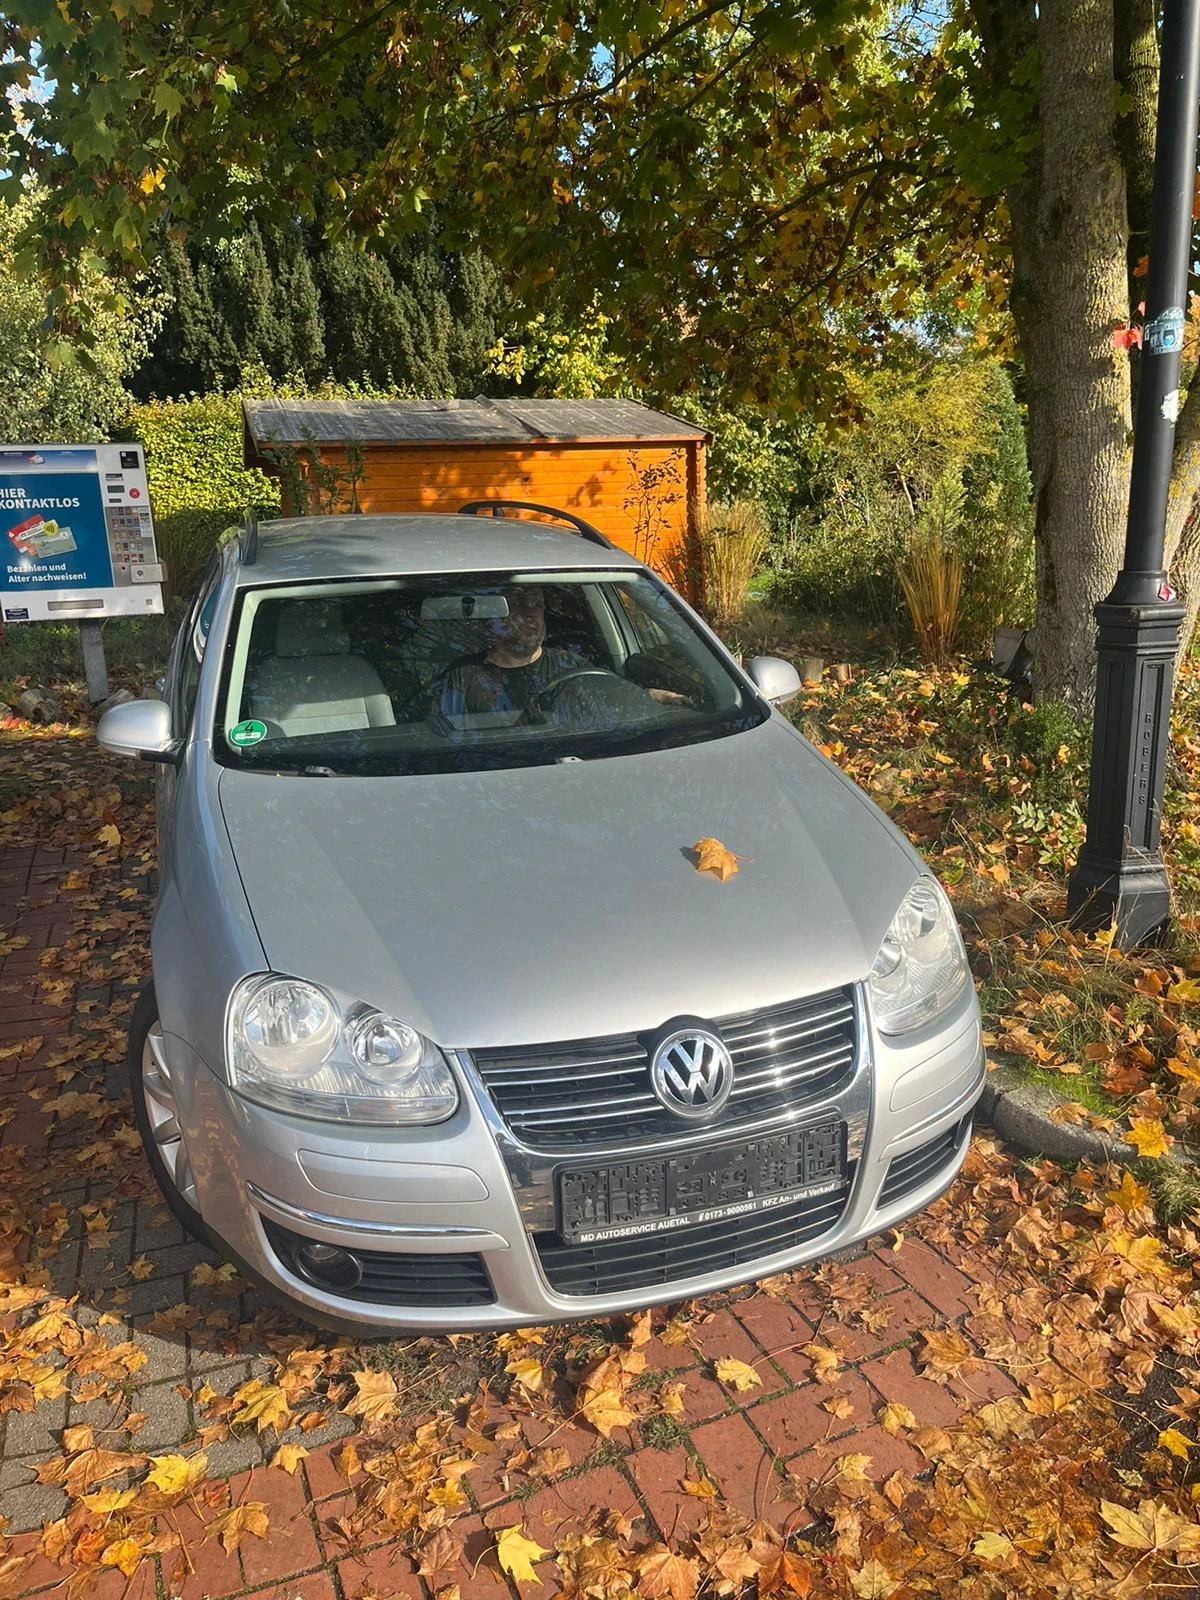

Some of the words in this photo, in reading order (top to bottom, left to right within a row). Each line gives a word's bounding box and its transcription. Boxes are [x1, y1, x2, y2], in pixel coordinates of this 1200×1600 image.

[0, 497, 80, 509] KONTAKTLOS
[7, 564, 47, 573] Bezahlen
[49, 563, 67, 571] und
[8, 575, 31, 583] Alter
[32, 572, 87, 581] nachweisen!
[244, 721, 255, 733] 4
[655, 1033, 729, 1109] VW
[580, 1234, 595, 1242] MD
[596, 1222, 657, 1240] AUTOSERVICE
[658, 1216, 691, 1230] AUETAL
[762, 1197, 779, 1208] KFZ
[793, 1190, 808, 1200] und
[808, 1182, 836, 1197] Verkauf
